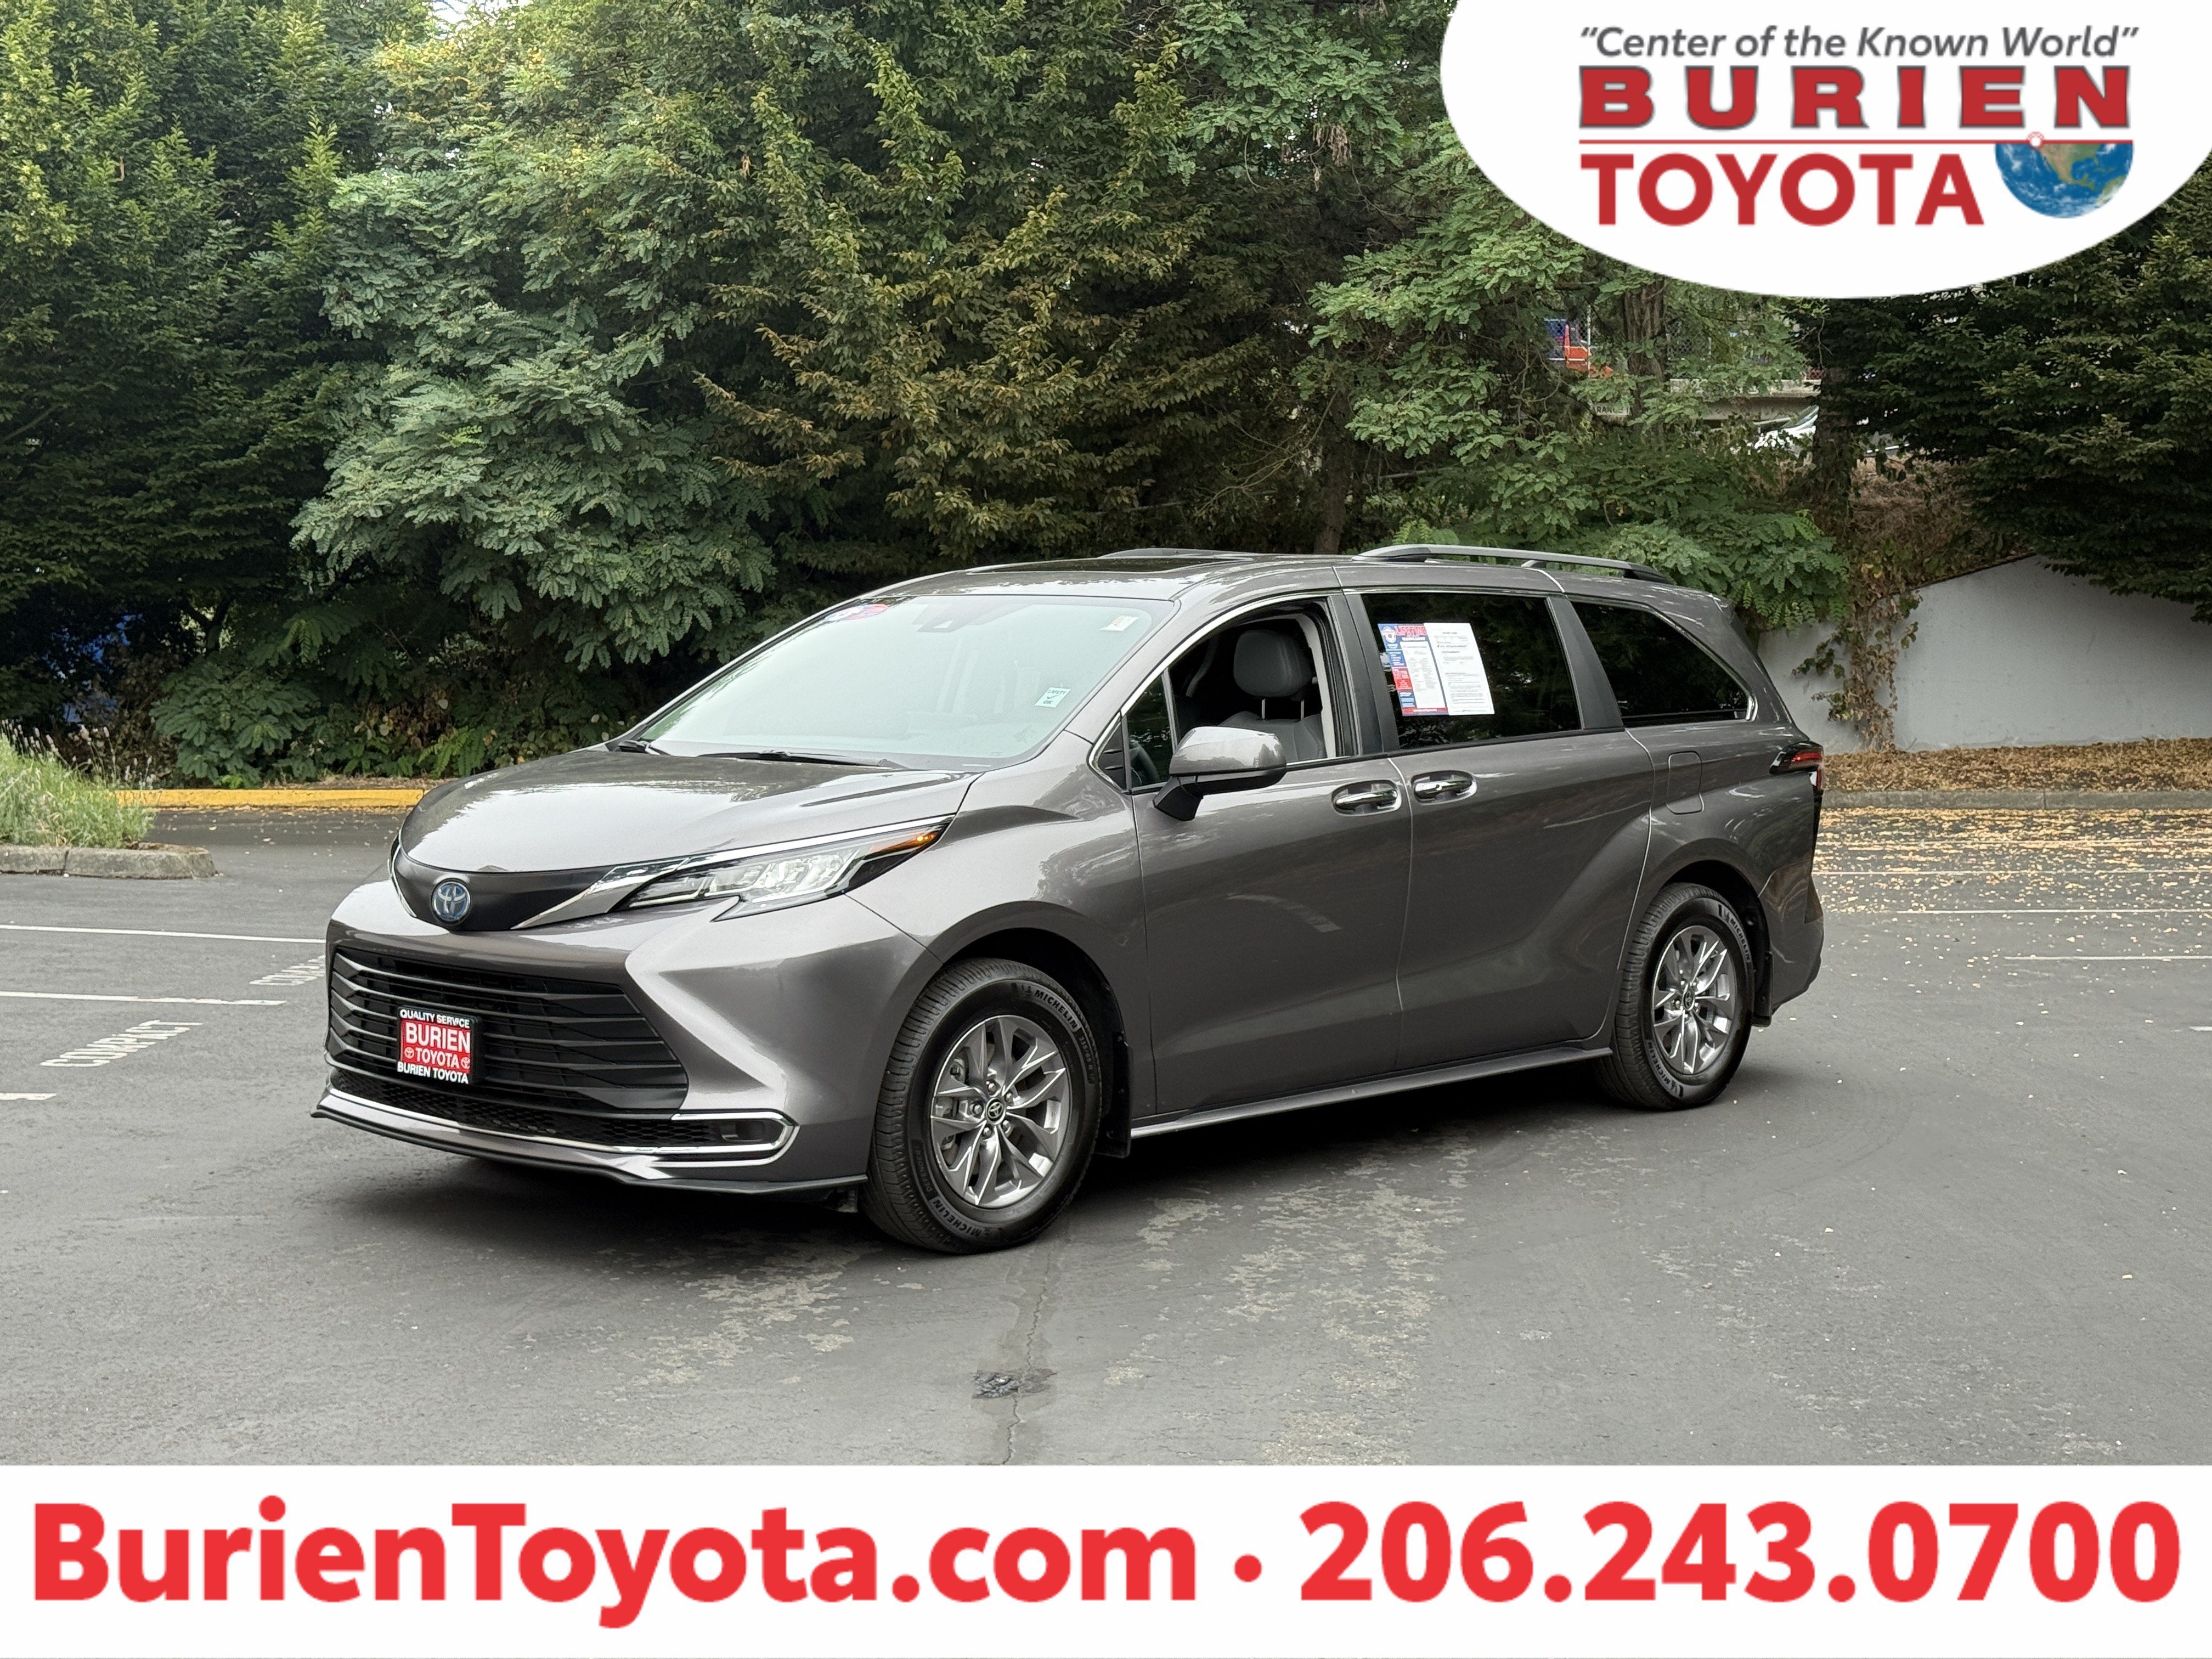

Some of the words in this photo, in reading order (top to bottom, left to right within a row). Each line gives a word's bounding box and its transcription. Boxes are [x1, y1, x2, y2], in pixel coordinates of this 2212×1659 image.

[1730, 918, 1750, 961] MICHELIN
[400, 1009, 435, 1022] QUALITY
[436, 1014, 470, 1029] SERVICE
[1035, 989, 1079, 1030] MICHELIN
[40, 1019, 203, 1067] COMPACT
[405, 1022, 471, 1054] BURIEN
[397, 1061, 431, 1078] BURIEN
[432, 1068, 469, 1085] TOYOTA
[415, 1047, 459, 1068] TOYOTA
[1647, 1042, 1671, 1085] MICHELIN
[933, 1199, 983, 1237] MICHELIN
